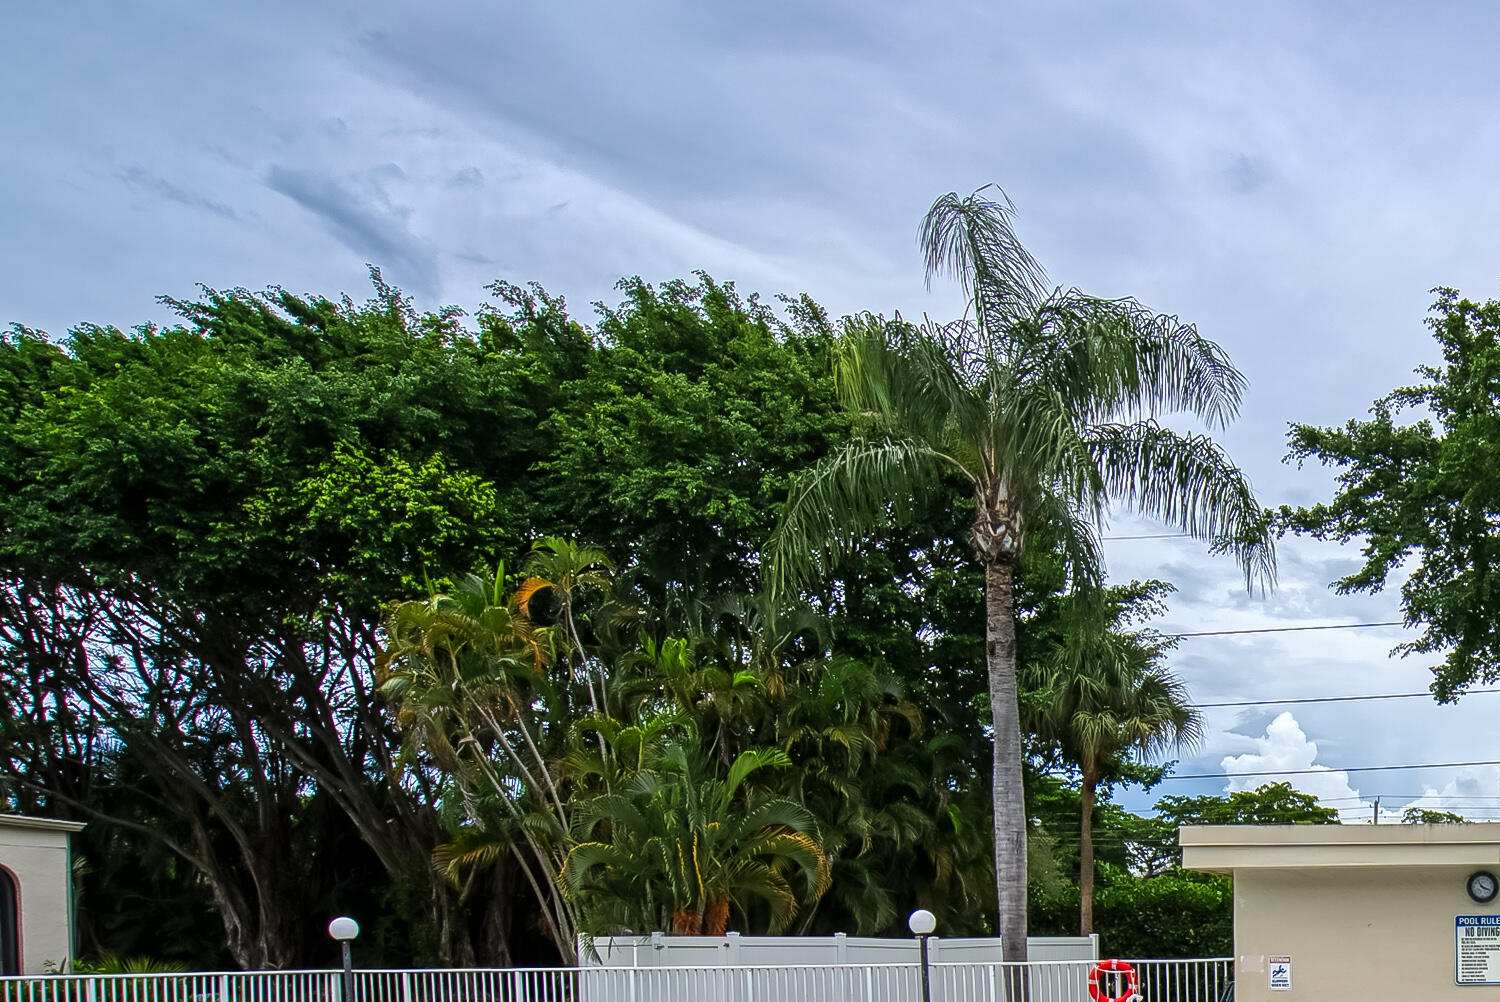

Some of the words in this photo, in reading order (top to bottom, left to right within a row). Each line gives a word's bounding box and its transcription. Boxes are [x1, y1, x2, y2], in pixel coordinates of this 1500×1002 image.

[1459, 917, 1479, 925] POOL
[1465, 926, 1475, 937] NO
[1476, 926, 1500, 937] DIVING
